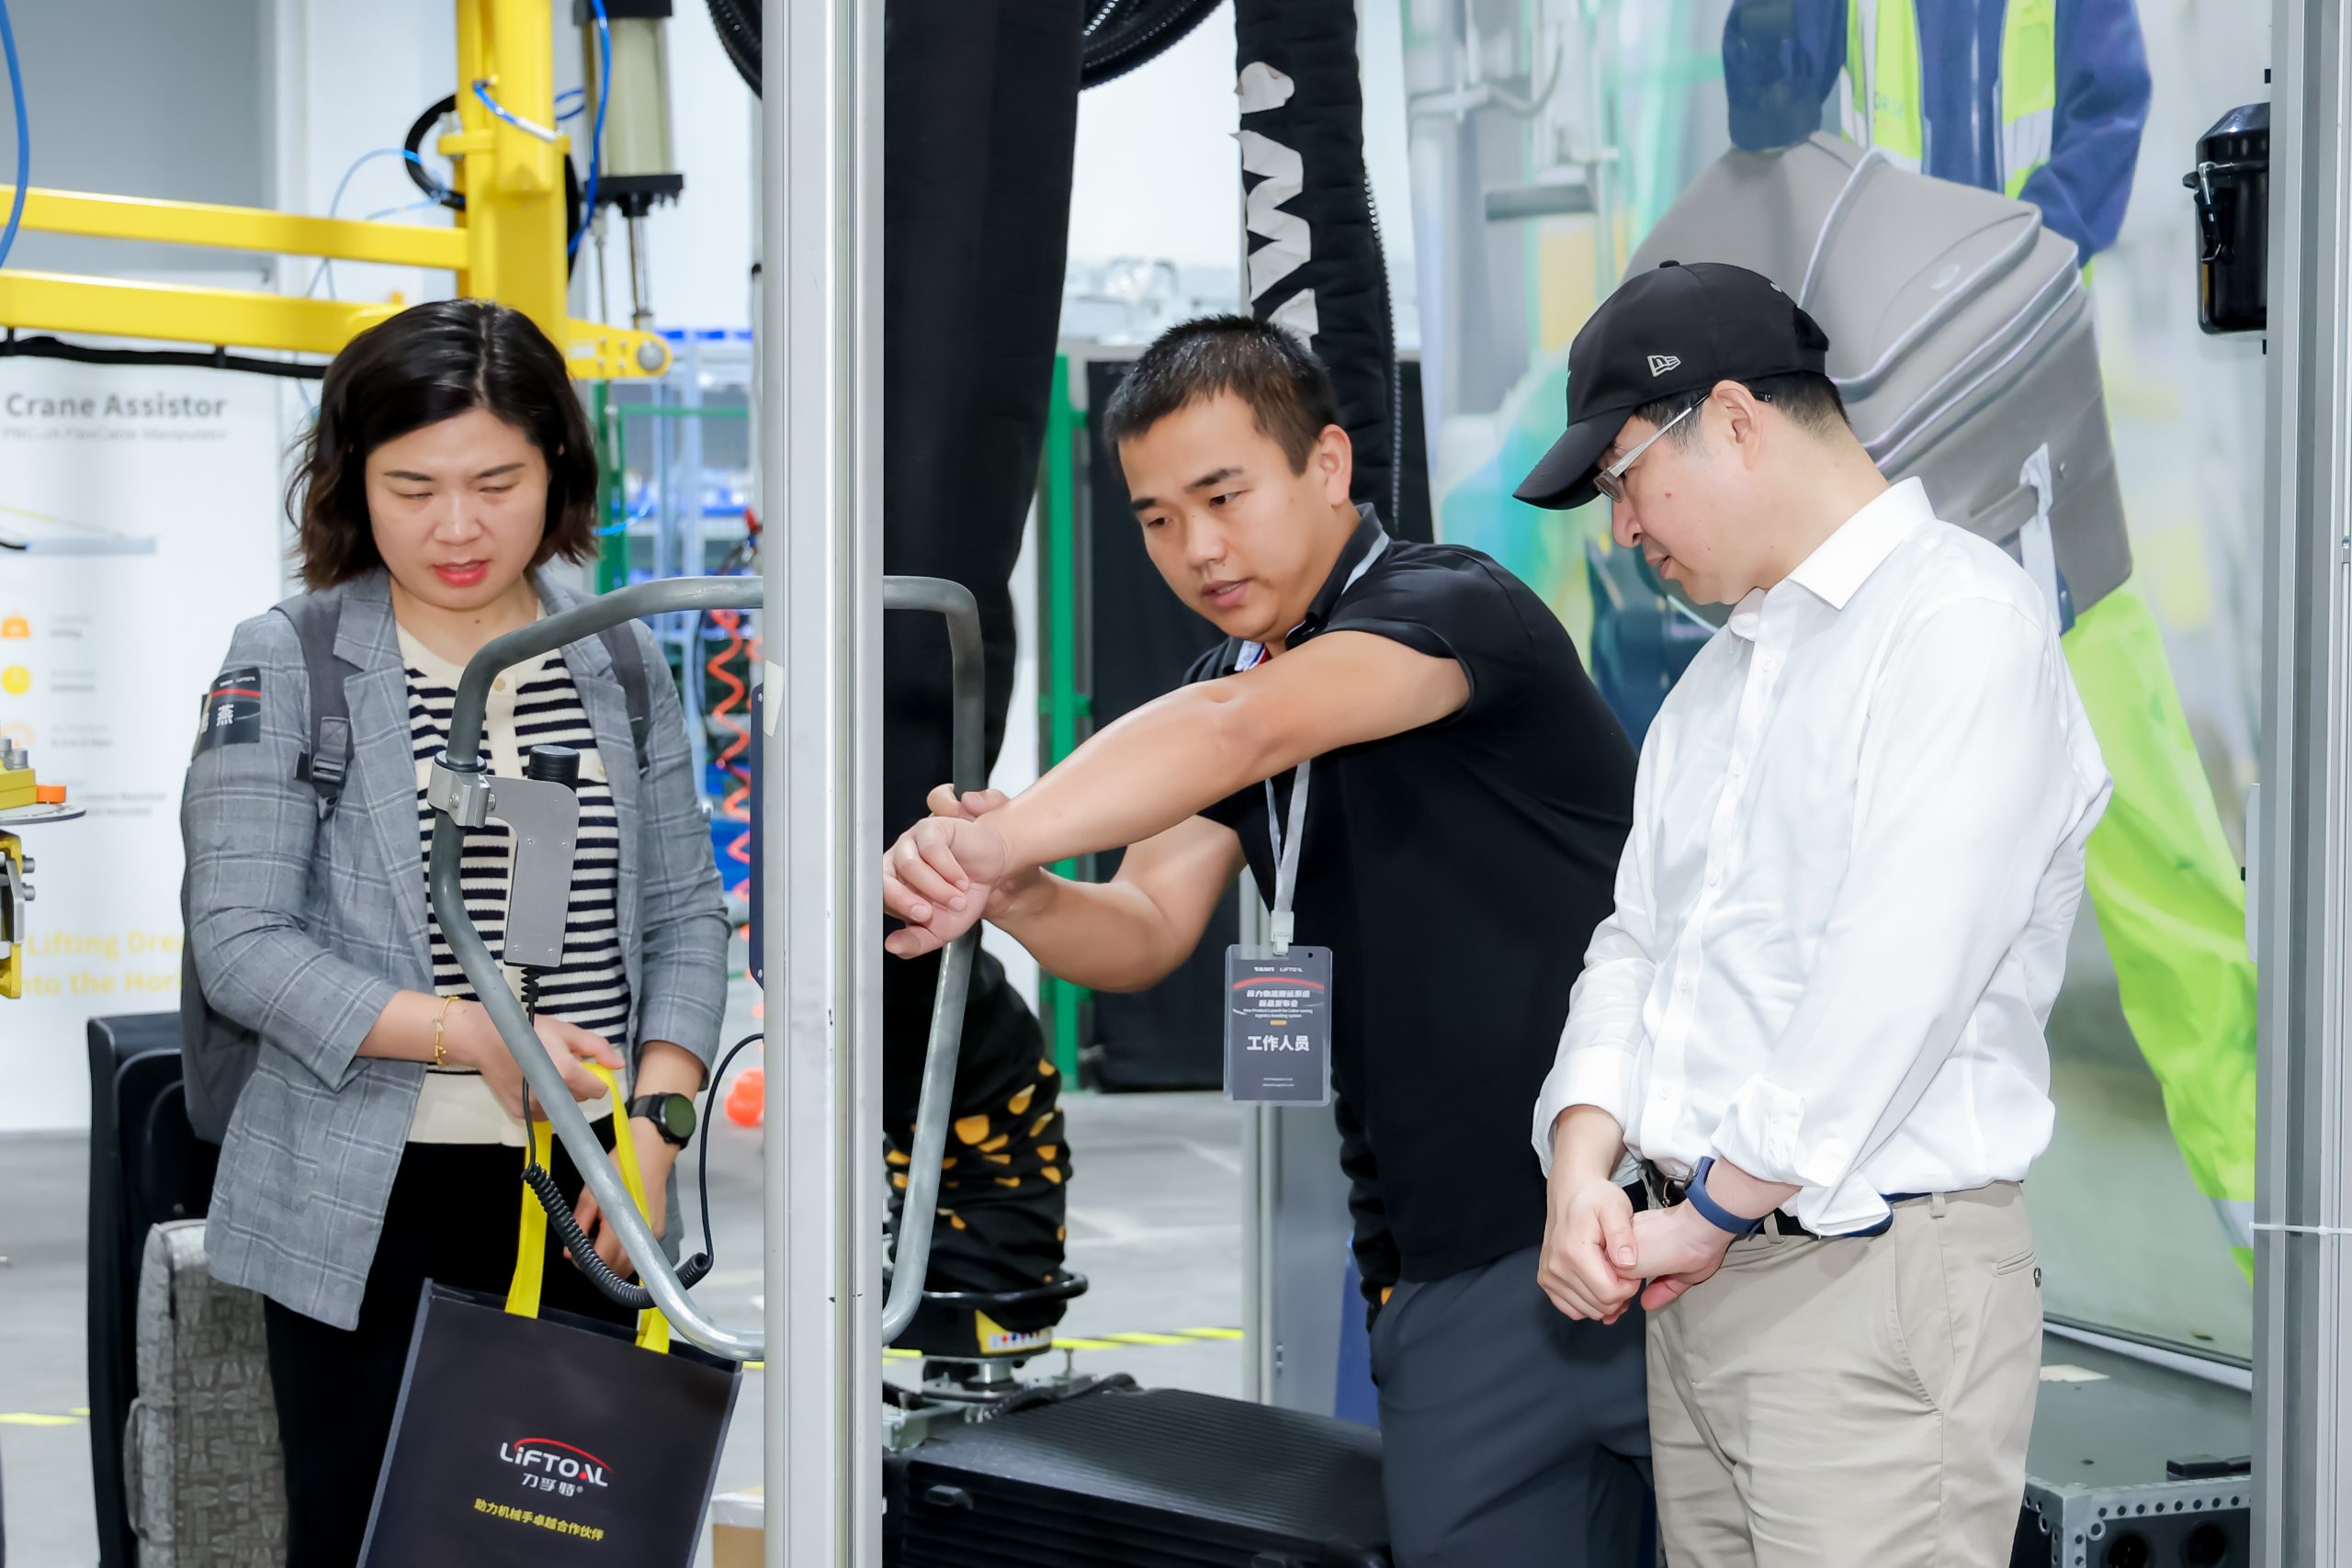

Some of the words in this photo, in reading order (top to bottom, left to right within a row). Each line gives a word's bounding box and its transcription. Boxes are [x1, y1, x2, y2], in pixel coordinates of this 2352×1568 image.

[6, 392, 96, 417] Crane
[105, 390, 228, 417] Assistor
[28, 930, 120, 960] Lifting
[70, 970, 115, 996] the
[1247, 1035, 1310, 1052] 工作人员
[474, 1497, 605, 1541] 助力机械手卓越合作伙伴
